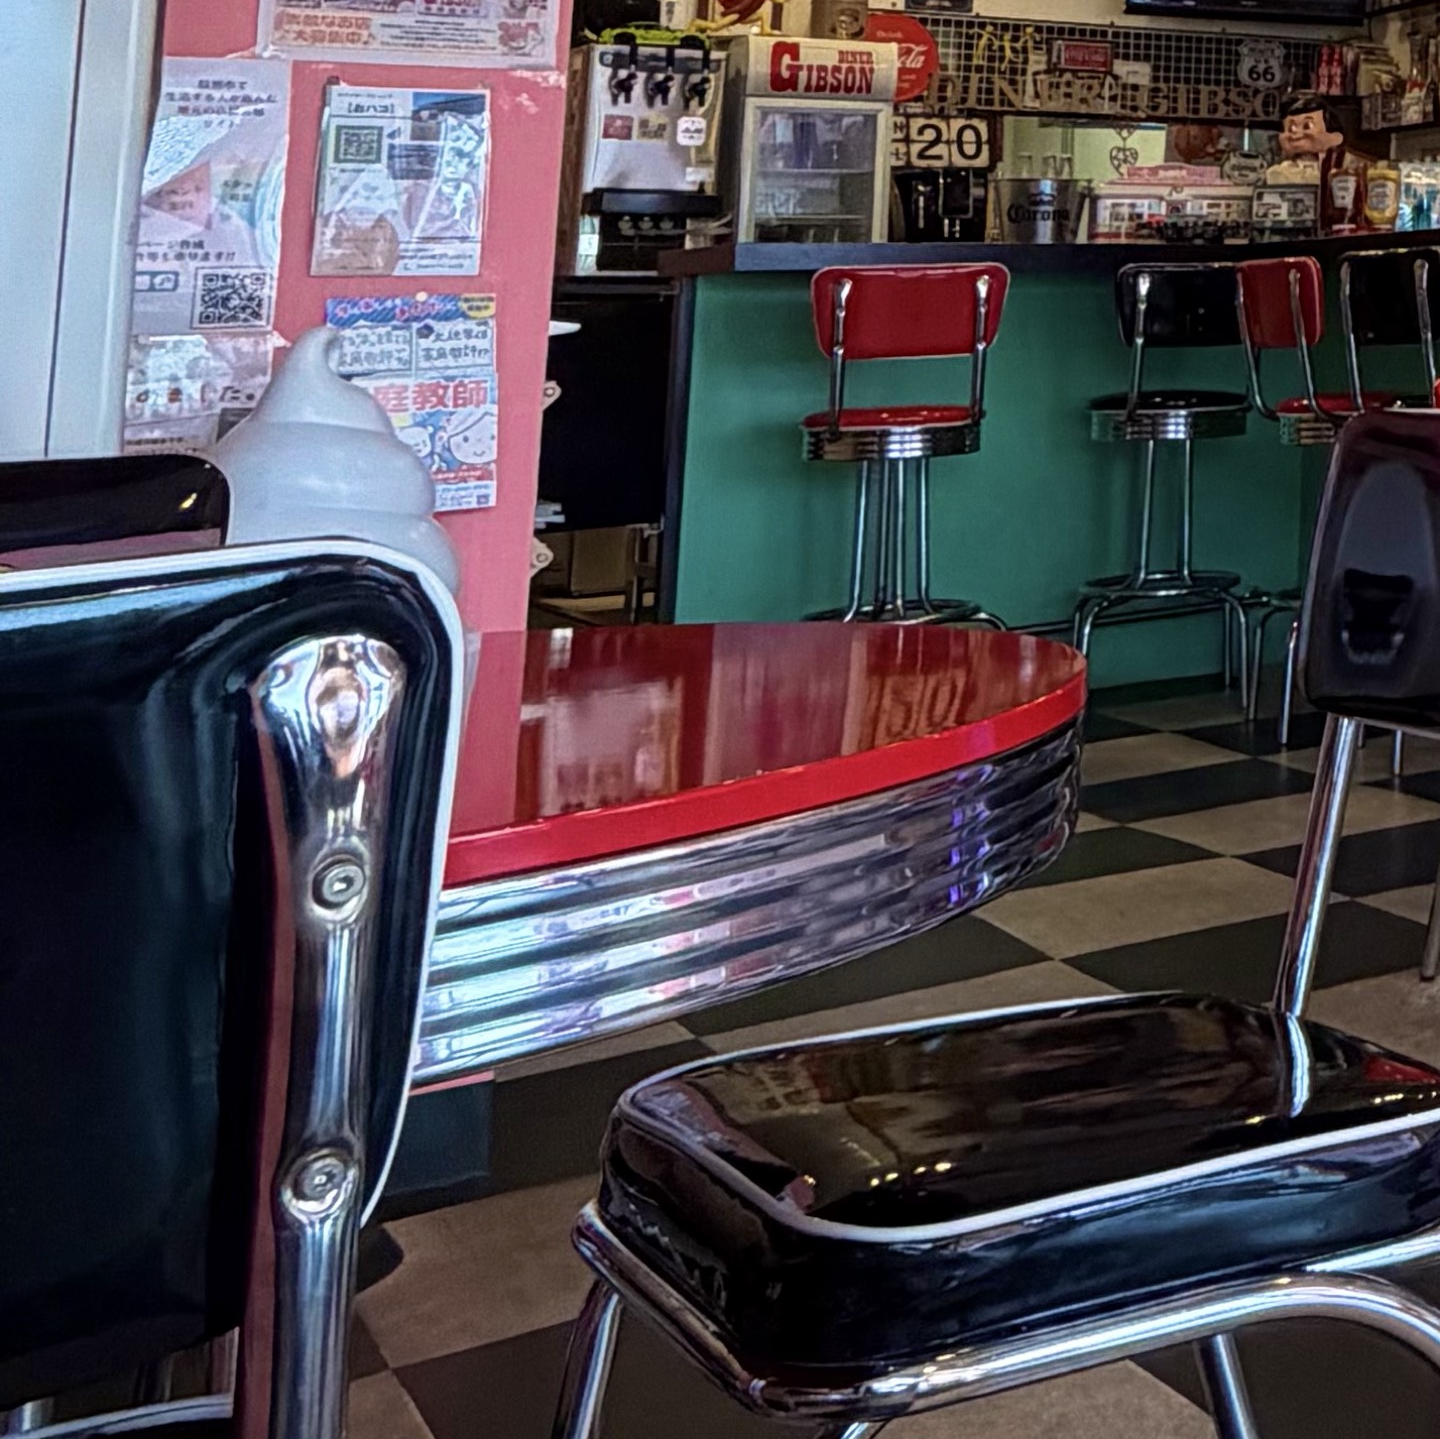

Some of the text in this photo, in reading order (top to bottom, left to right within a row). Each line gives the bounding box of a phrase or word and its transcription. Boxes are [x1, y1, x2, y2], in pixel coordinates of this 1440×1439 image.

[769, 40, 877, 95] GIBSON
[1247, 64, 1276, 84] 66
[1006, 204, 1070, 224] Corona
